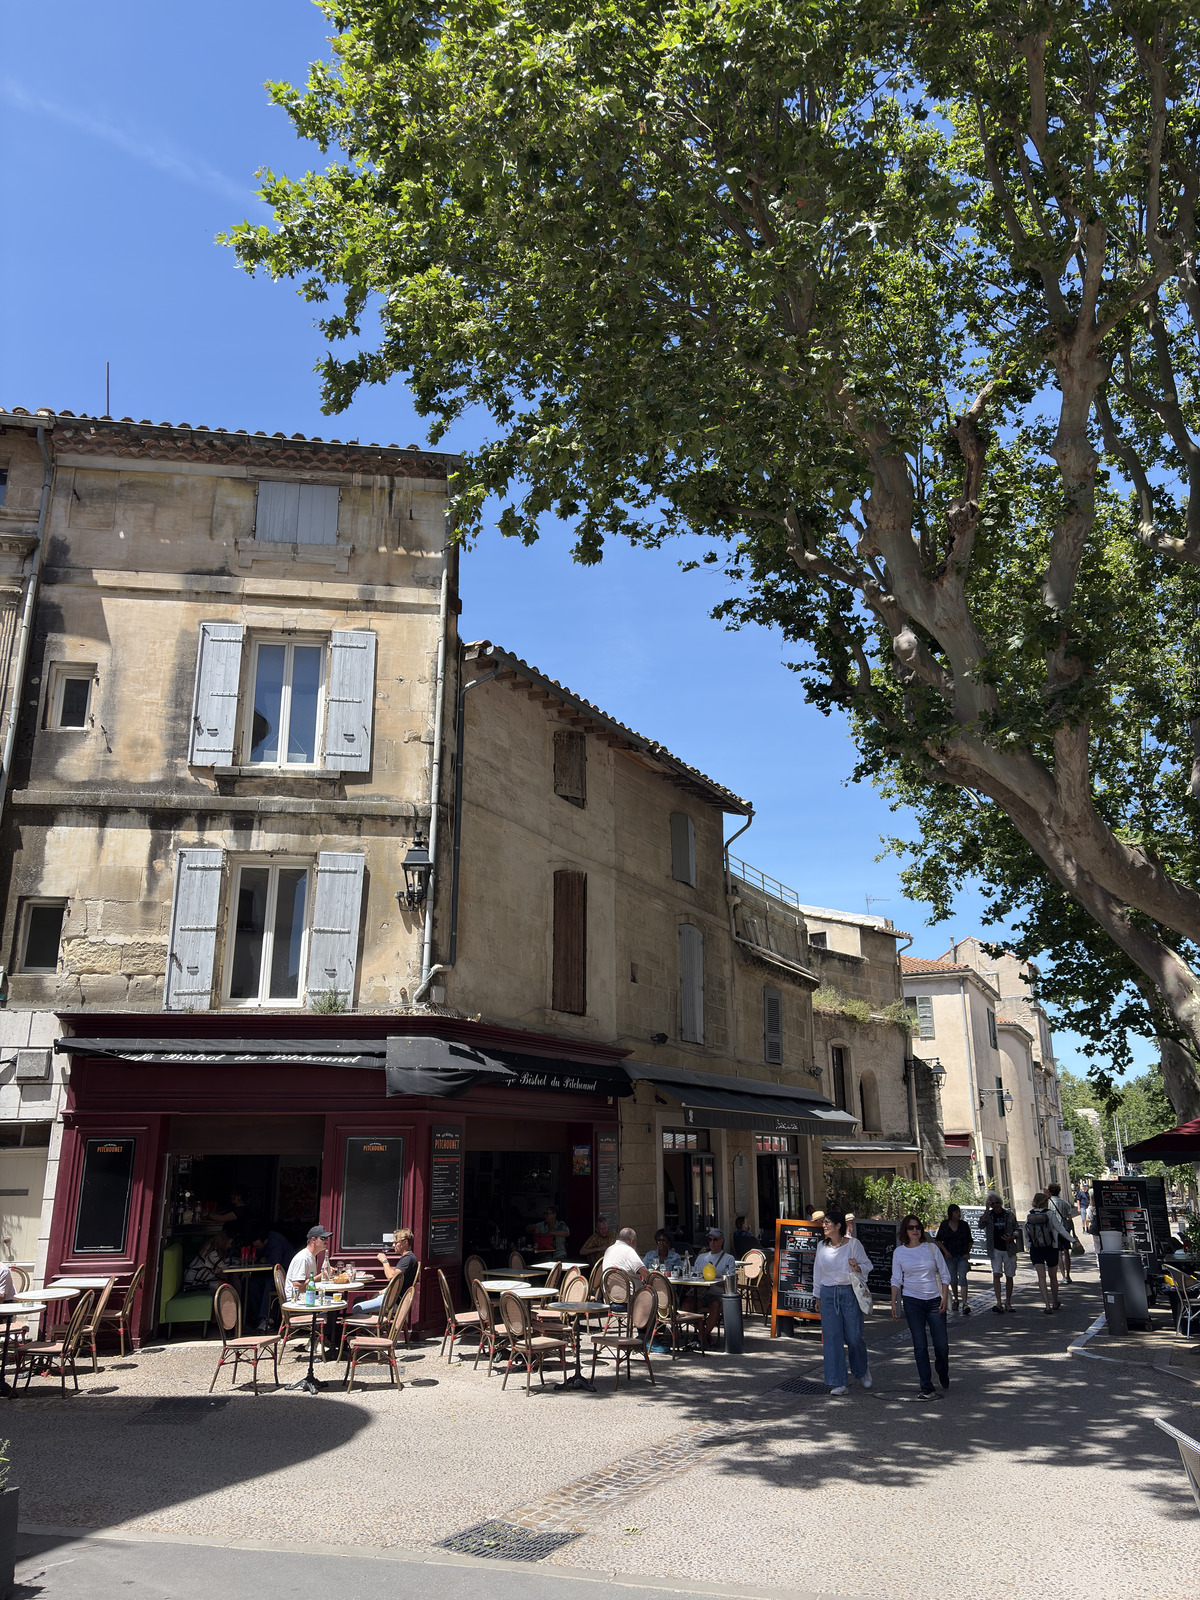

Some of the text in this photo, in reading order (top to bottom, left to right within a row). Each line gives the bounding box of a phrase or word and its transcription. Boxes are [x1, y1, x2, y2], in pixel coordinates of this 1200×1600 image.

[160, 1053, 226, 1061] Bistrot
[520, 1071, 547, 1086] Bistrot
[550, 1076, 560, 1087] du
[563, 1076, 598, 1091] Pitchounet
